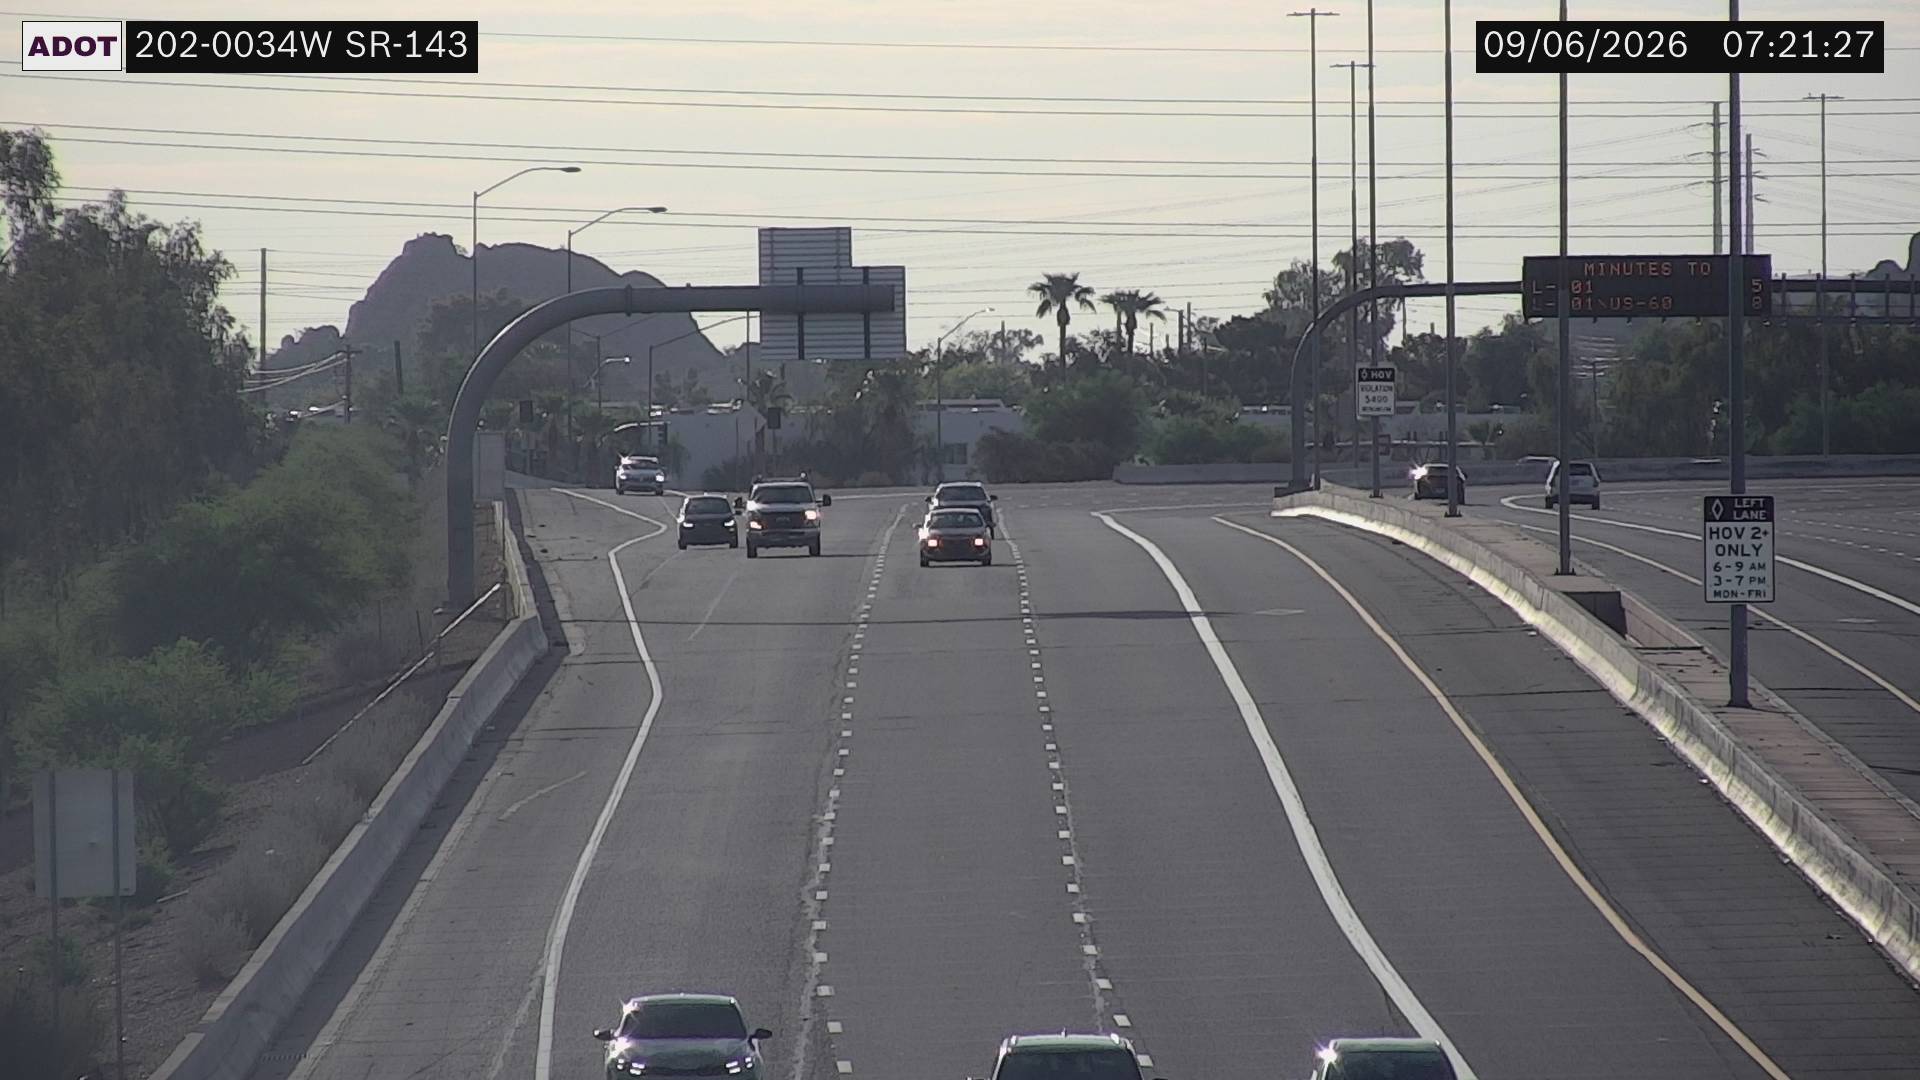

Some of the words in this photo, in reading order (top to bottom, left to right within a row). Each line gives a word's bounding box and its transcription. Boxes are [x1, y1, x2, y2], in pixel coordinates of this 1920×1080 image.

[1584, 262, 1672, 276] MINUTES
[1688, 262, 1711, 275] TO
[1532, 280, 1593, 294] L-01
[1751, 279, 1762, 292] 5
[1370, 370, 1392, 379] HOV
[1735, 498, 1764, 508] LEFT
[1733, 510, 1766, 520] LANE
[1709, 526, 1745, 540] HOV
[1750, 526, 1769, 540] 2+
[1715, 543, 1763, 557] ONLY
[1749, 562, 1766, 571] AM
[1749, 576, 1766, 585] PM
